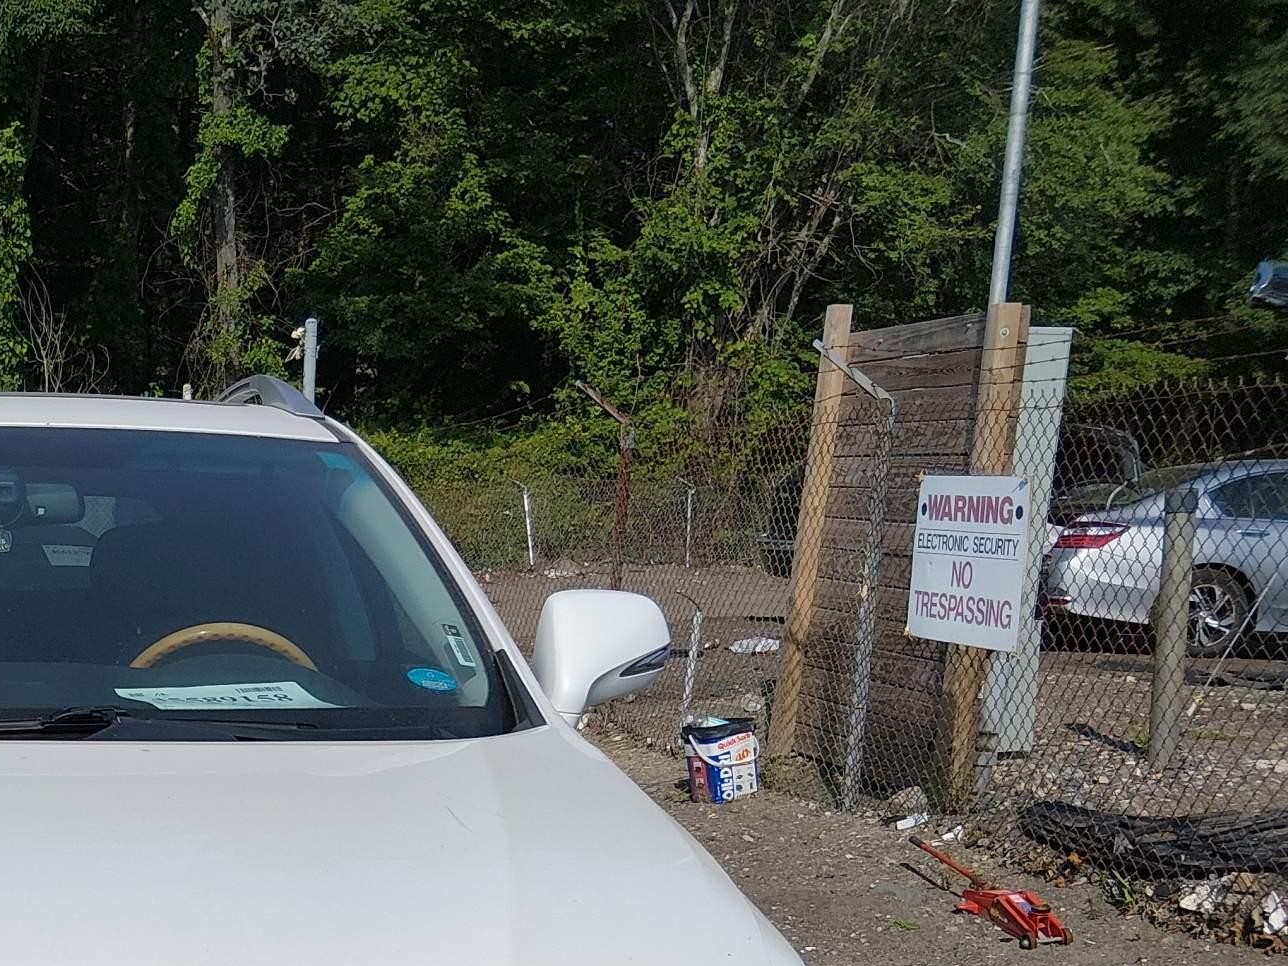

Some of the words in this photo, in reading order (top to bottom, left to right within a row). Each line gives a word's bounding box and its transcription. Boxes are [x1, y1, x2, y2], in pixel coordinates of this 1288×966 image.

[927, 494, 1014, 525] WARNING
[917, 532, 969, 553] ELECTRONIC
[972, 536, 1020, 557] SECURITY
[950, 560, 973, 589] NO
[914, 589, 1012, 630] TRESPASSING
